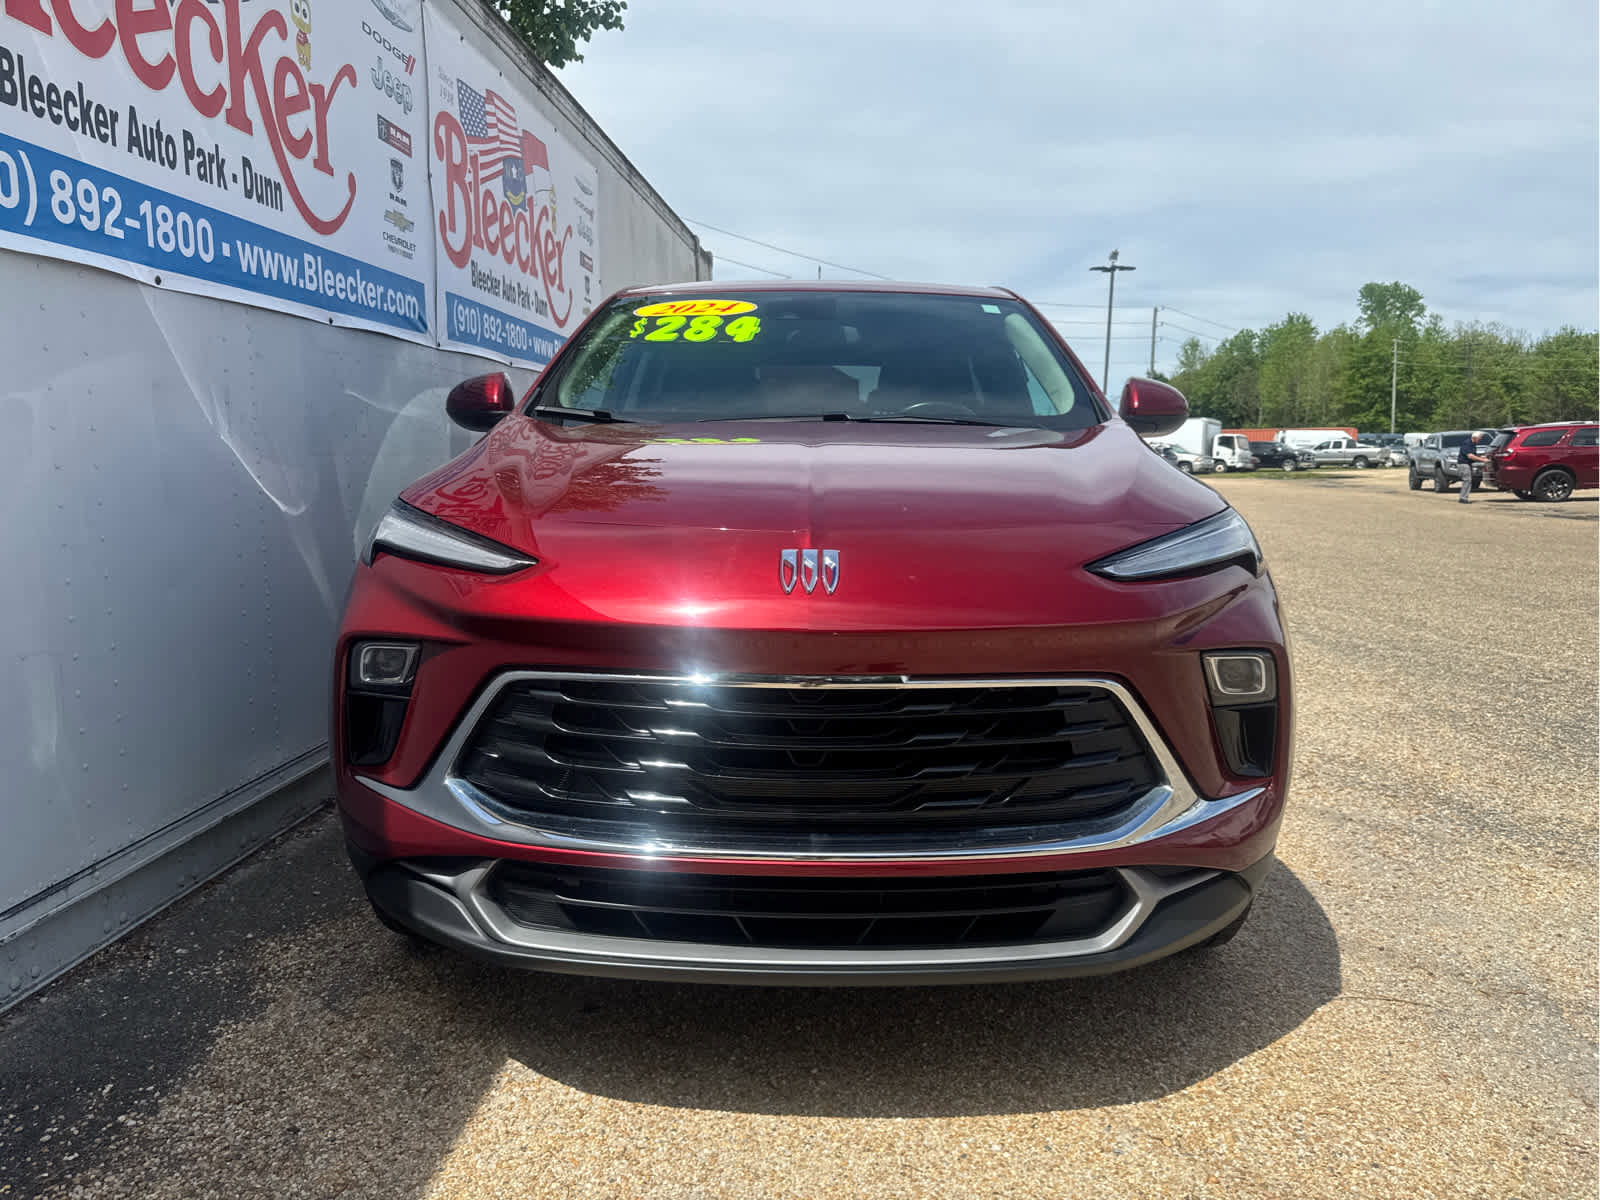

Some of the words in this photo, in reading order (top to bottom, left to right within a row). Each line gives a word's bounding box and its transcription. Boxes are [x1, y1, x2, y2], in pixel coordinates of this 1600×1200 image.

[361, 21, 409, 66] DODGE
[371, 56, 413, 115] Jeep
[0, 46, 119, 147] Bleecker
[127, 105, 177, 170] Auto
[183, 129, 229, 191] Park
[242, 156, 284, 212] Dunn
[50, 169, 215, 264] 892-1800
[236, 240, 419, 320] www.Bleecker.com
[382, 231, 417, 252] CHEVROLET
[434, 111, 573, 328] Bleecker
[471, 259, 501, 297] Bleecker
[502, 274, 516, 305] Auto
[517, 281, 531, 311] Park
[535, 289, 548, 318] Dunn
[653, 302, 739, 316] 2024
[453, 298, 481, 342] (910)
[483, 313, 528, 352] 892-1800
[629, 315, 761, 343] $284
